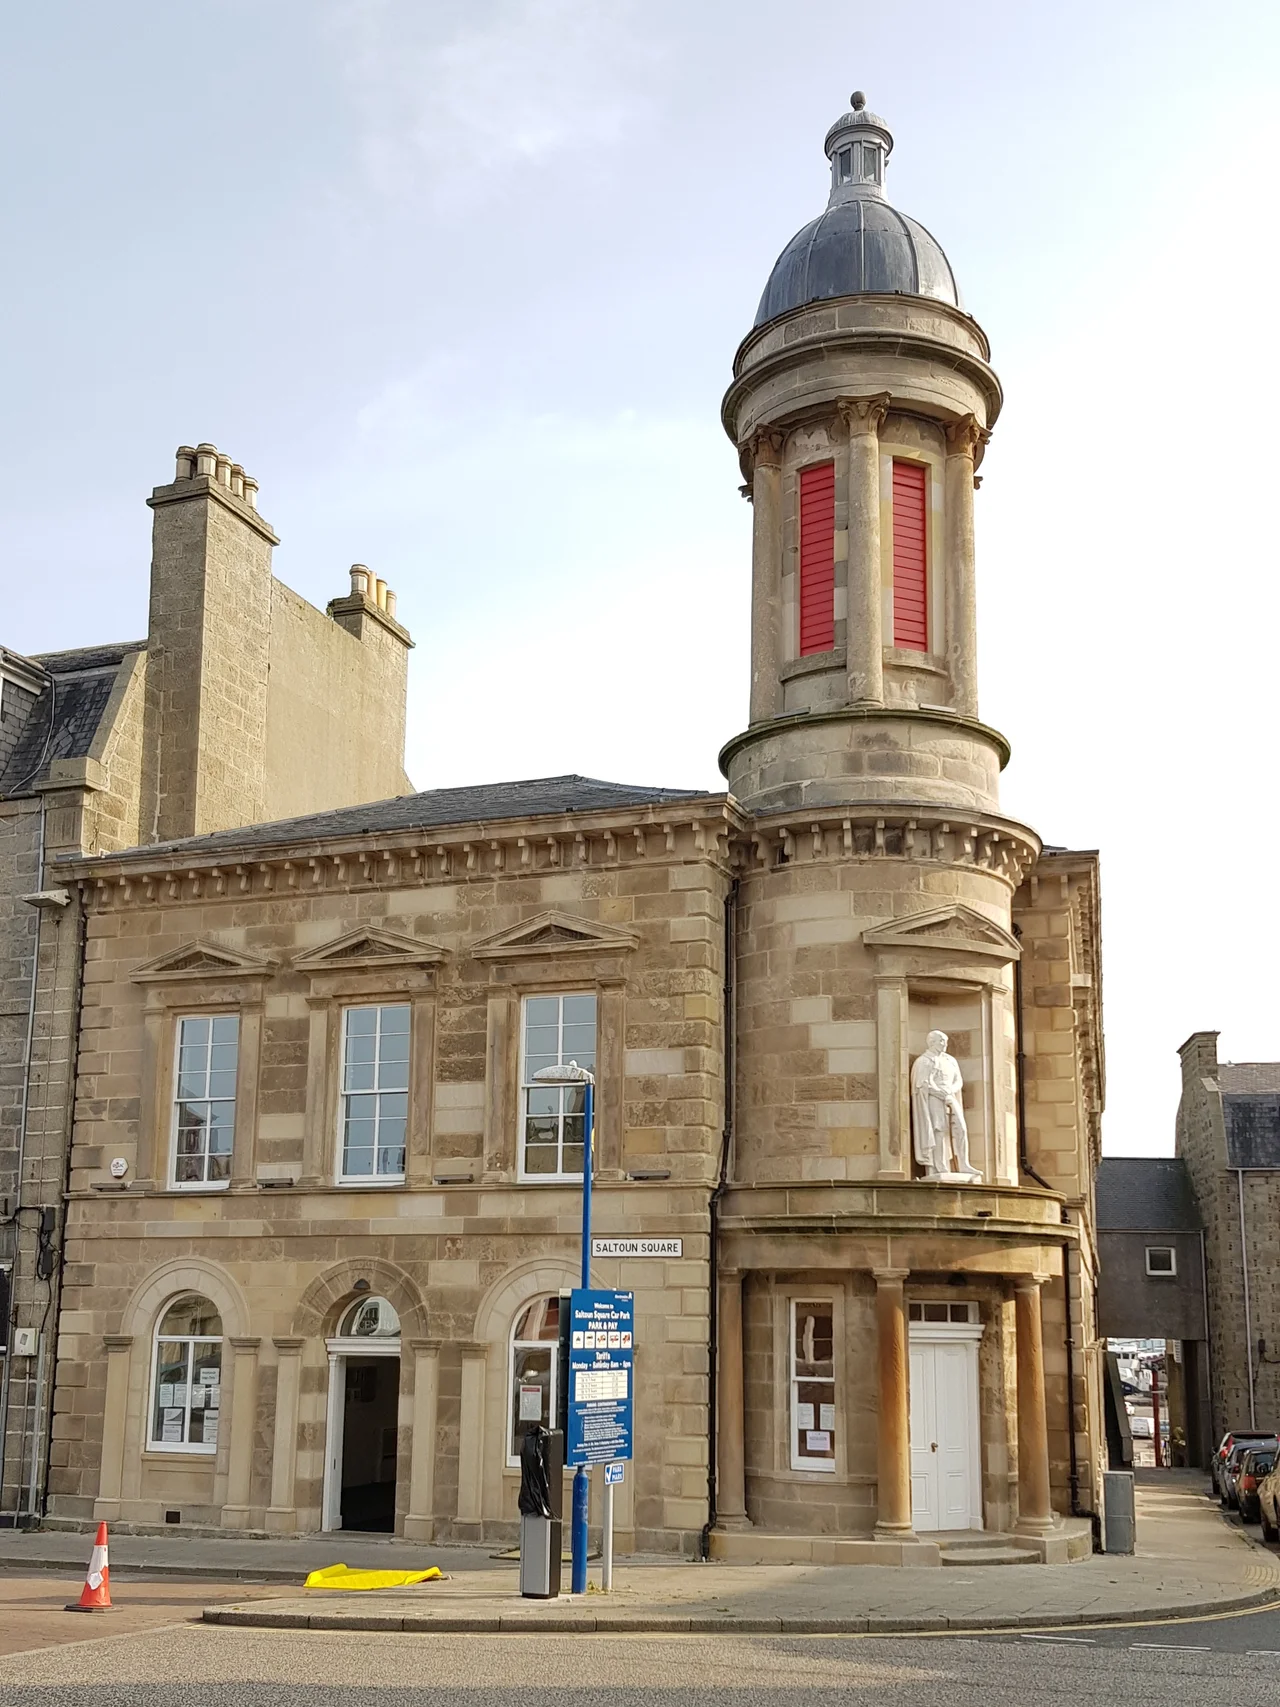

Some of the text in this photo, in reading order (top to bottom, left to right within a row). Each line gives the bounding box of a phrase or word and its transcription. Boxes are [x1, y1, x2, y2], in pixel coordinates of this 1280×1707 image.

[596, 1243, 678, 1252] SALTOUN SQUARE
[575, 1310, 630, 1320] Saltoun Square Car Park
[588, 1321, 618, 1330] PARK & PAY
